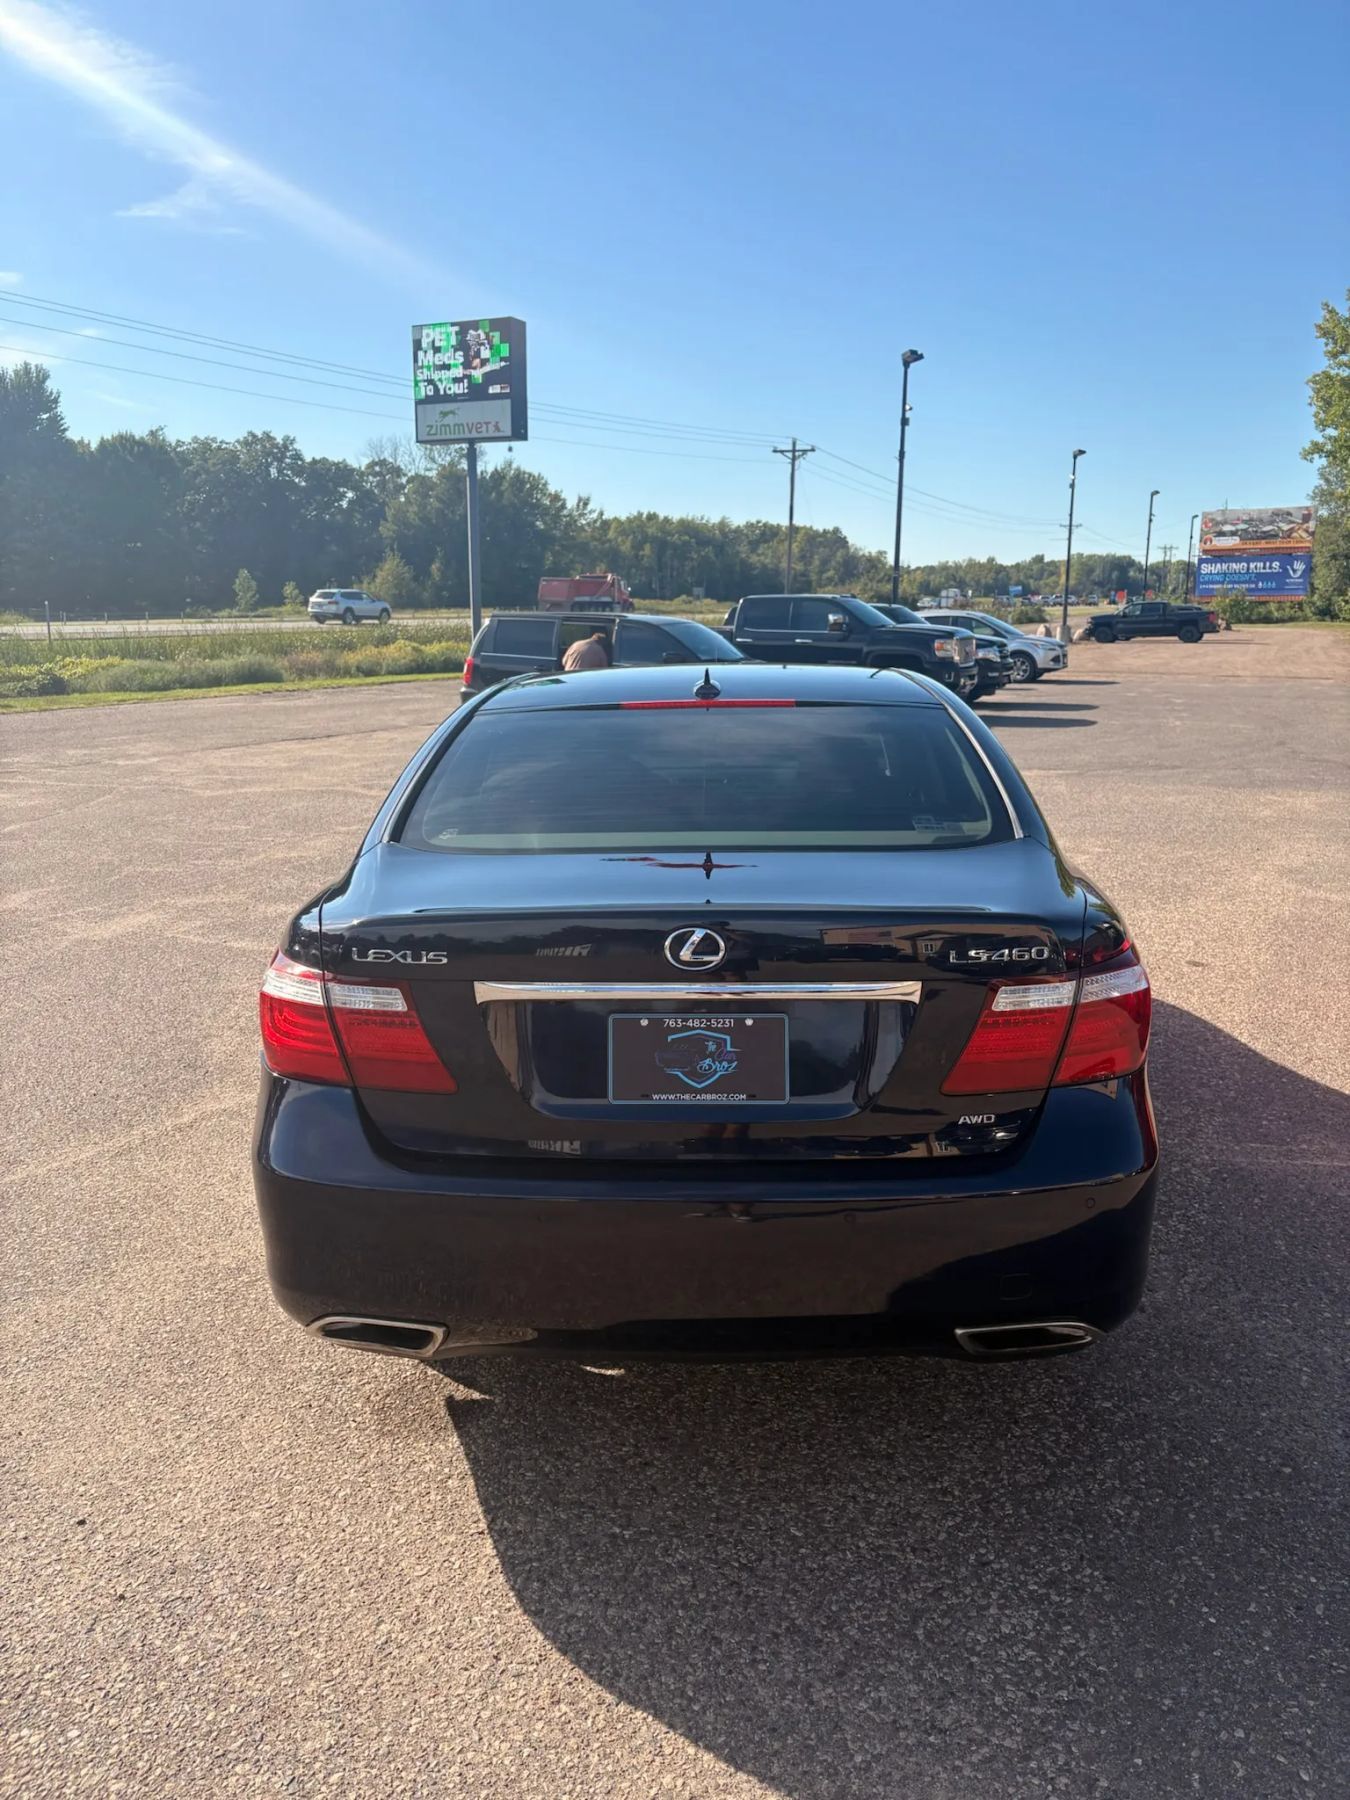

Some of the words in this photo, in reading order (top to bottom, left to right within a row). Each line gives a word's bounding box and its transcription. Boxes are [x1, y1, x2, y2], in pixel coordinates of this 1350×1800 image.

[421, 326, 459, 348] PET
[418, 349, 464, 366] Meds
[418, 382, 433, 396] To
[436, 379, 468, 395] You!
[1201, 562, 1247, 574] SHAKING
[1249, 561, 1282, 573] KILLS.
[351, 947, 448, 965] LEXUS
[663, 1018, 734, 1028] 763-482-5231
[651, 1093, 746, 1101] WWW.THECARBROZ.COM
[957, 1114, 996, 1125] AWD
